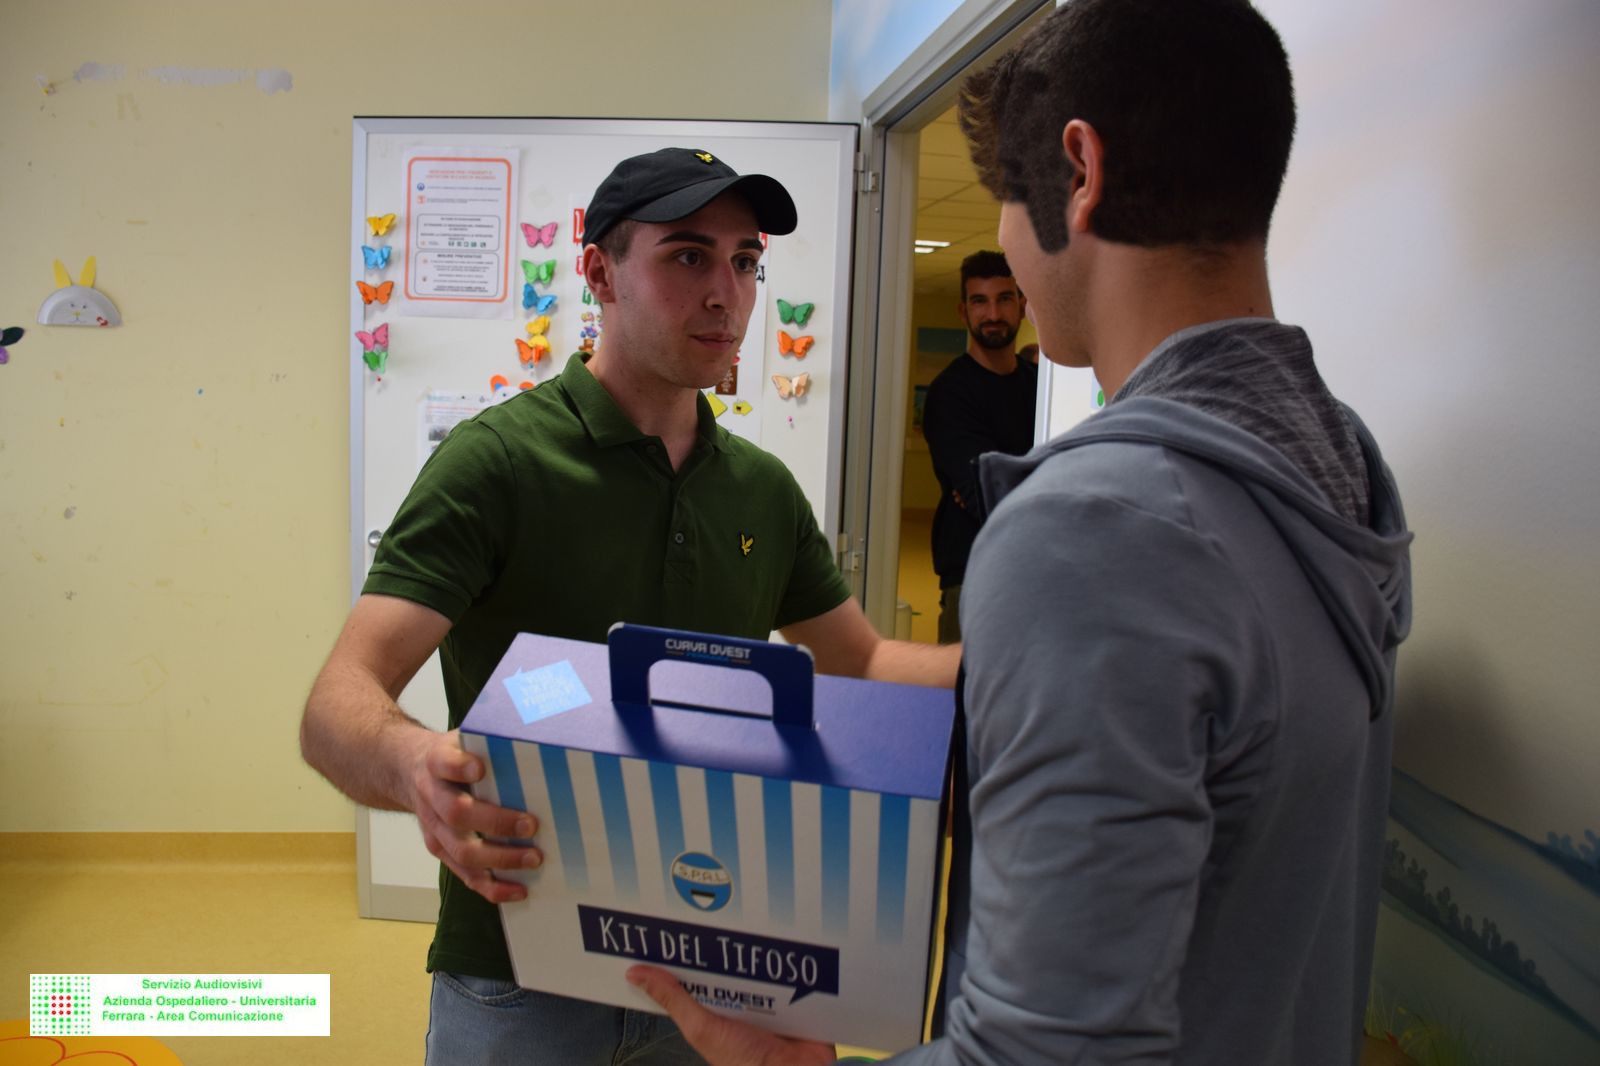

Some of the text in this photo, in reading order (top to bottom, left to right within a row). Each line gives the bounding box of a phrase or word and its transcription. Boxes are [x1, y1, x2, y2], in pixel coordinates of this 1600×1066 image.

[665, 638, 707, 653] CURVA
[709, 643, 752, 659] OVEST
[599, 916, 818, 986] KIT DEL TIFOSO
[714, 987, 776, 1010] OVEST
